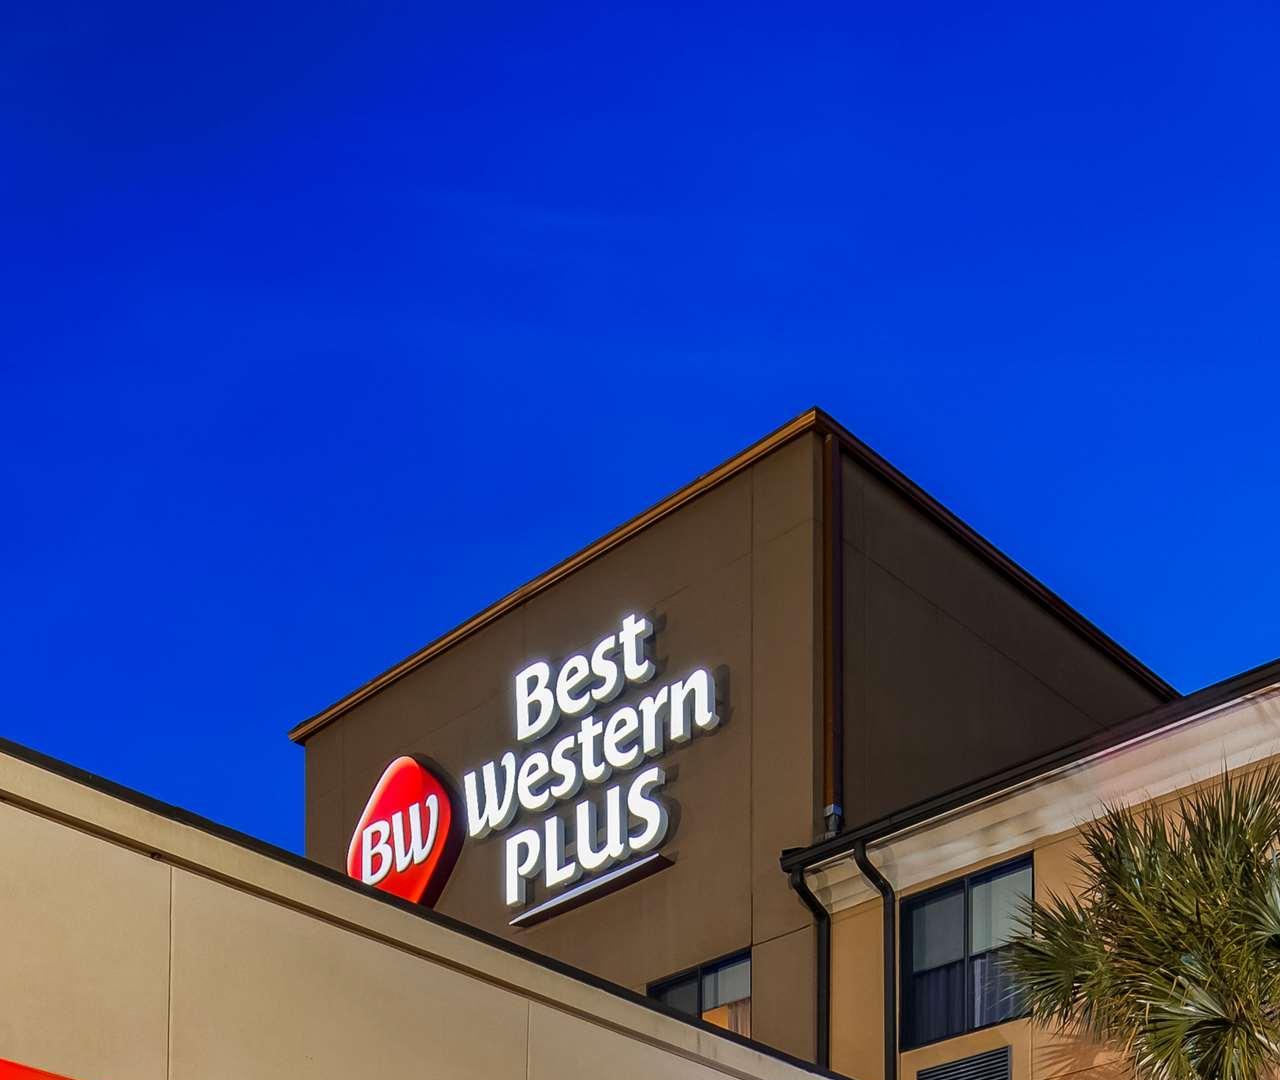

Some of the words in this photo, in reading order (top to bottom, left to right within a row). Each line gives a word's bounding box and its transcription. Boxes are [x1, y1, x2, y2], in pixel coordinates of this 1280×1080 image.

[516, 613, 653, 742] Best
[463, 668, 718, 838] Western
[361, 794, 439, 886] BW
[506, 767, 669, 905] PLUS
